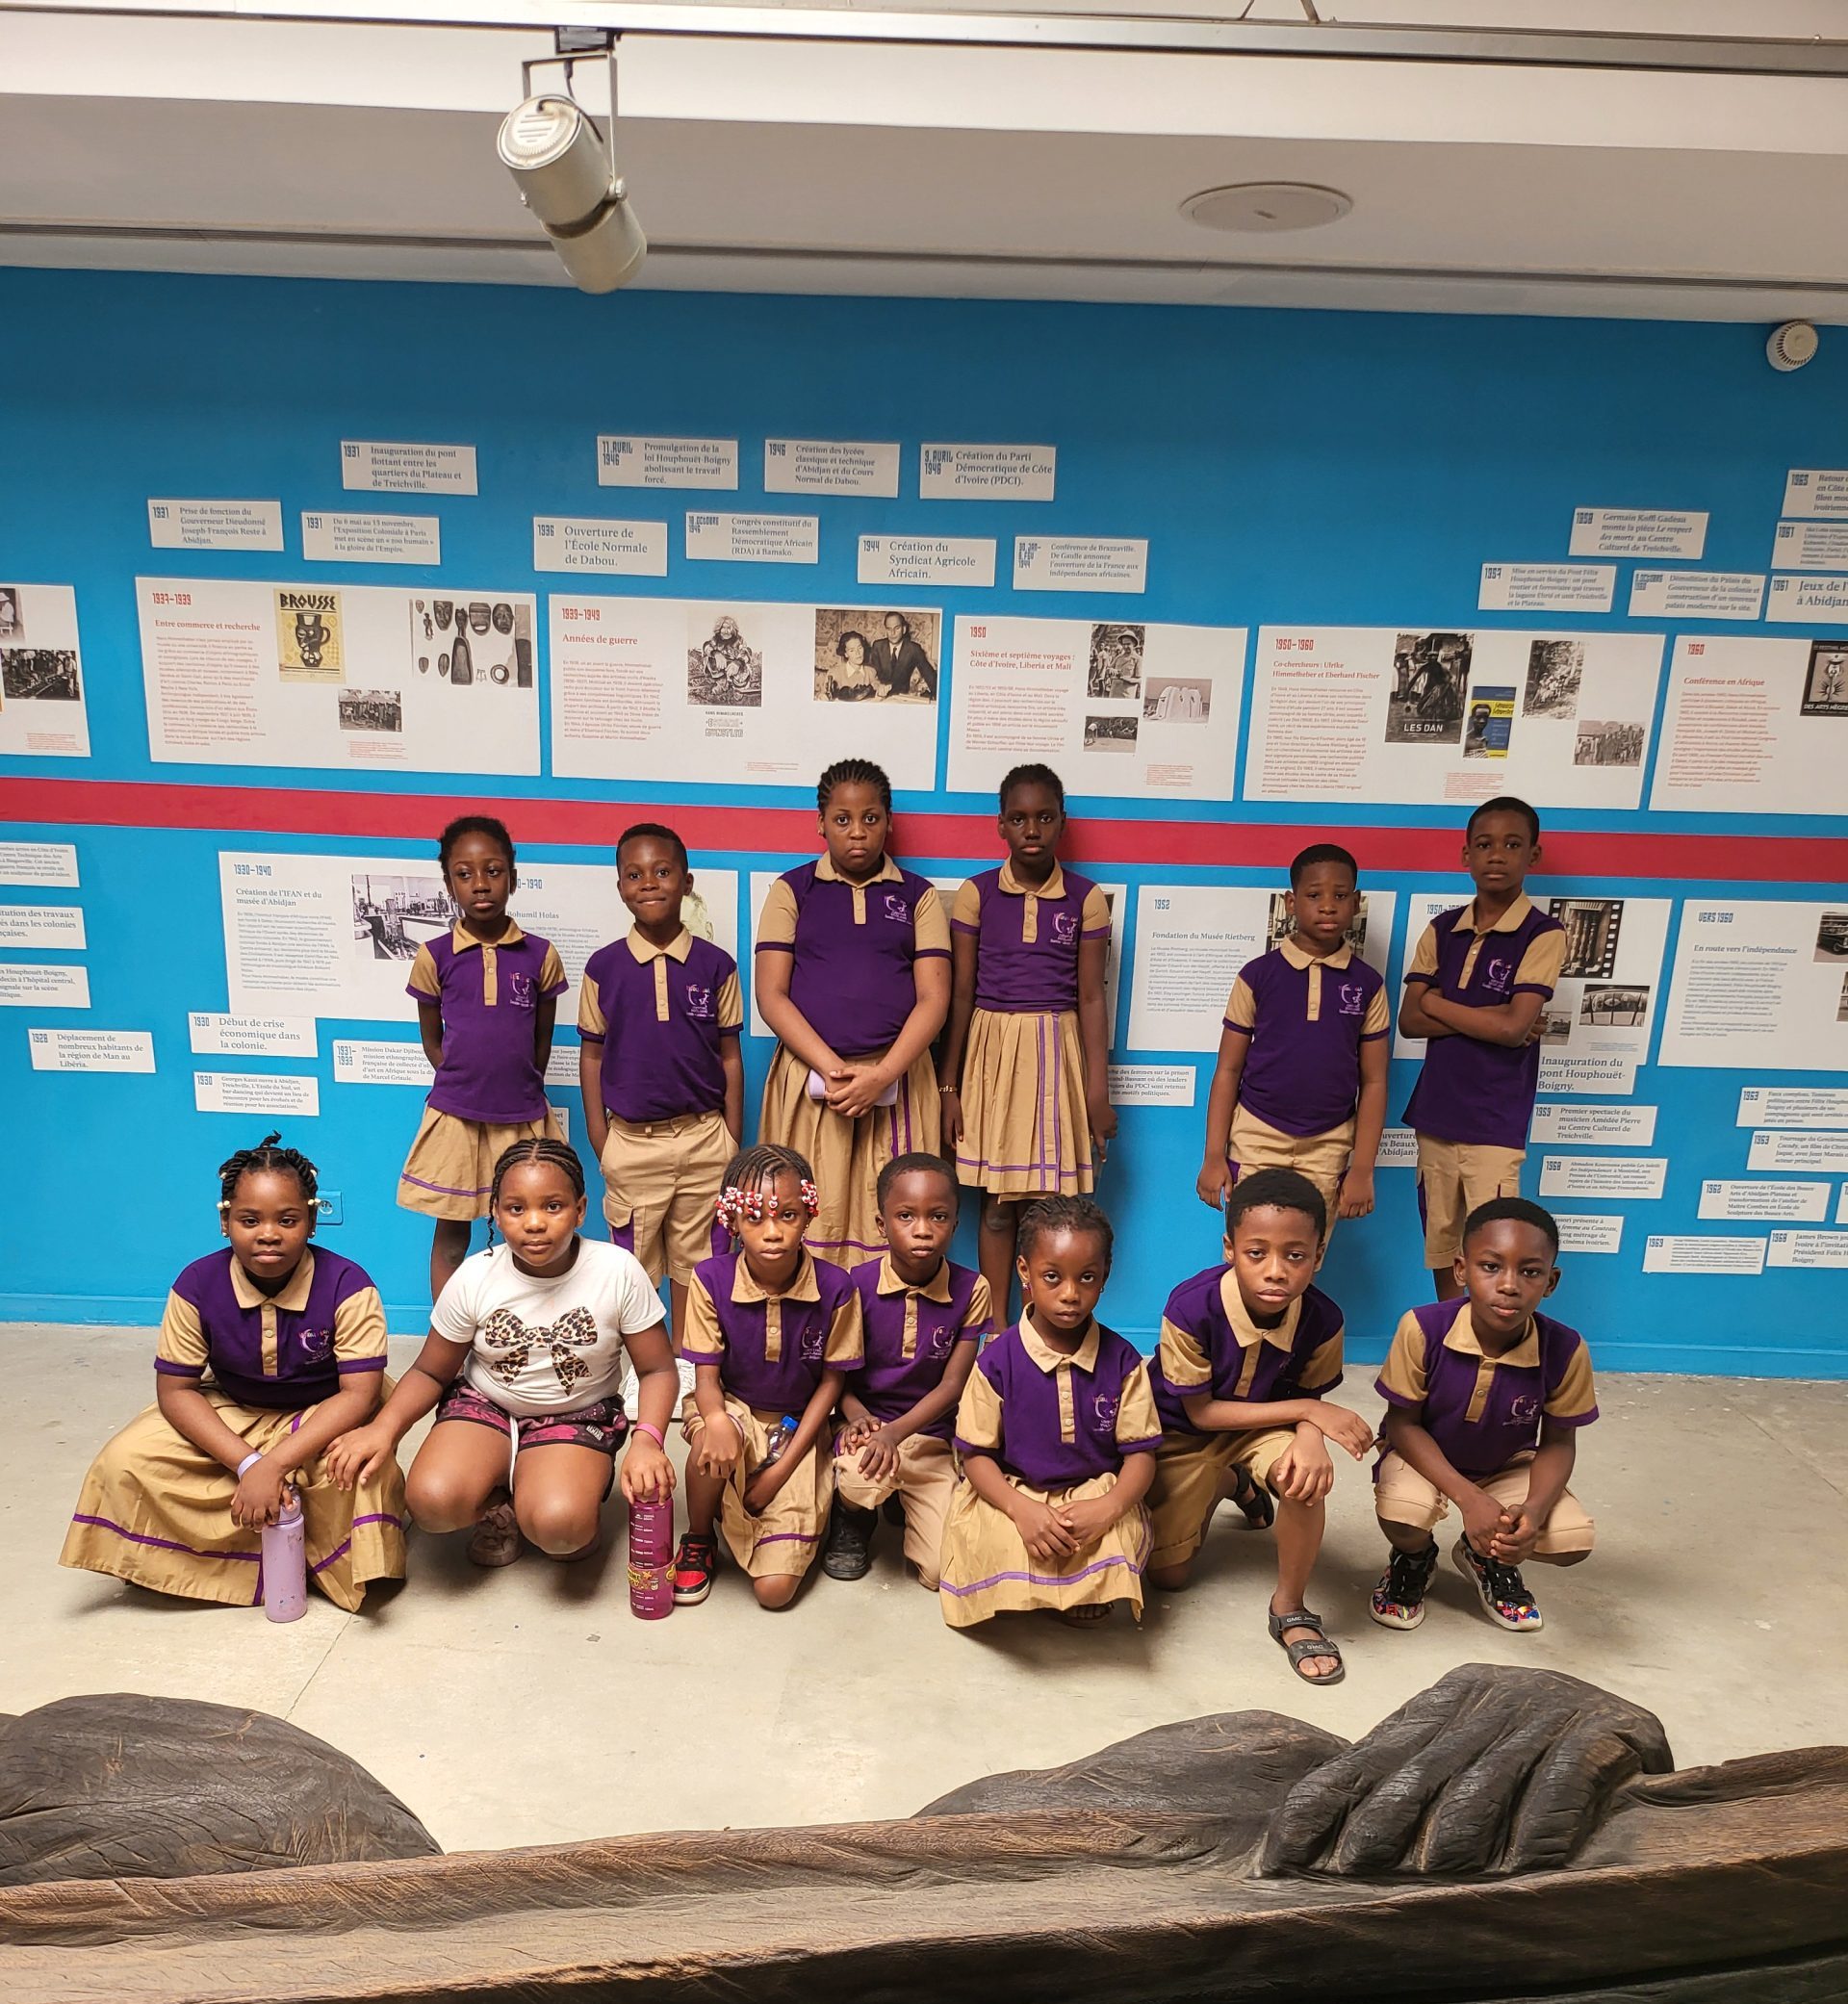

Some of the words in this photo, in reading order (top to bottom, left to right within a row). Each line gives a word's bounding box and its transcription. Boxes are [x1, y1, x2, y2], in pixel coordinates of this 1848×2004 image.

[344, 446, 360, 457] 1931
[371, 446, 424, 456] Inauguration
[424, 449, 436, 457] du
[438, 450, 456, 459] pont
[644, 442, 699, 453] Promulgation
[701, 444, 710, 453] de
[712, 445, 719, 453] la
[603, 453, 620, 466] 1946
[644, 452, 654, 462] loi
[656, 453, 732, 466] Houphouët-Boigny
[956, 450, 994, 461] Création
[995, 451, 1008, 461] du
[1010, 452, 1031, 462] Parti
[371, 456, 401, 467] flottant
[425, 458, 437, 468] les
[372, 469, 409, 478] quartiers
[409, 470, 421, 478] du
[422, 470, 452, 479] Plateau
[644, 464, 684, 474] abolissant
[686, 465, 693, 475] le
[695, 467, 721, 475] travail
[956, 462, 1017, 475] Démocratique
[1019, 464, 1031, 474] de
[1032, 464, 1052, 474] Côte
[372, 478, 382, 487] de
[383, 478, 427, 489] Treichville.
[644, 475, 666, 484] forcé.
[955, 475, 989, 485] d'Ivoire
[989, 474, 1023, 486] (PDCI).
[732, 517, 761, 527] Congrès
[537, 525, 554, 536] 1936
[564, 526, 619, 538] Ouverture
[621, 527, 633, 538] de
[732, 527, 788, 537] Rassemblement
[565, 537, 601, 552] l'École
[602, 542, 648, 553] Normale
[732, 536, 783, 548] Démocratique
[783, 539, 812, 548] Africain
[863, 540, 880, 552] 1944
[889, 541, 933, 552] Création
[935, 542, 948, 552] du
[732, 547, 755, 556] (RDA)
[761, 547, 793, 556] Bamako.
[565, 553, 578, 565] de
[580, 555, 618, 566] Dabou.
[889, 554, 933, 566] Syndicat
[935, 556, 976, 567] Agricole
[888, 568, 931, 578] Africain.
[1799, 580, 1824, 592] Jeux
[1826, 581, 1840, 591] de
[279, 592, 336, 610] BROUSSE
[155, 619, 176, 628] Entre
[970, 626, 987, 638] 1950
[562, 633, 595, 643] Années
[596, 635, 607, 644] de
[608, 637, 638, 646] guerre
[1009, 652, 1041, 660] septième
[988, 660, 1018, 670] d'Ivoire,
[1324, 670, 1355, 679] Eberhard
[1683, 677, 1726, 685] Conférence
[1736, 679, 1765, 687] Afrique
[1403, 723, 1422, 732] LES
[1424, 724, 1443, 732] DAN
[236, 887, 268, 896] Création
[278, 889, 302, 898] l'IFAN
[261, 898, 296, 908] d'Abidjan
[1742, 945, 1798, 955] l'indépendance
[193, 1016, 210, 1027] 1930
[218, 1017, 248, 1027] Début
[249, 1018, 263, 1027] de
[262, 1019, 285, 1028] crise
[56, 1034, 106, 1042] Déplacement
[219, 1029, 277, 1041] économique
[277, 1030, 300, 1040] dans
[58, 1042, 97, 1051] nombreux
[220, 1040, 229, 1048] la
[231, 1040, 268, 1050] colonie.
[66, 1051, 91, 1061] région
[1541, 1056, 1607, 1068] Inauguration
[1609, 1058, 1623, 1067] du
[1539, 1068, 1563, 1079] pont
[1565, 1068, 1625, 1081] Houphouët-
[1538, 1081, 1575, 1091] Boigny.
